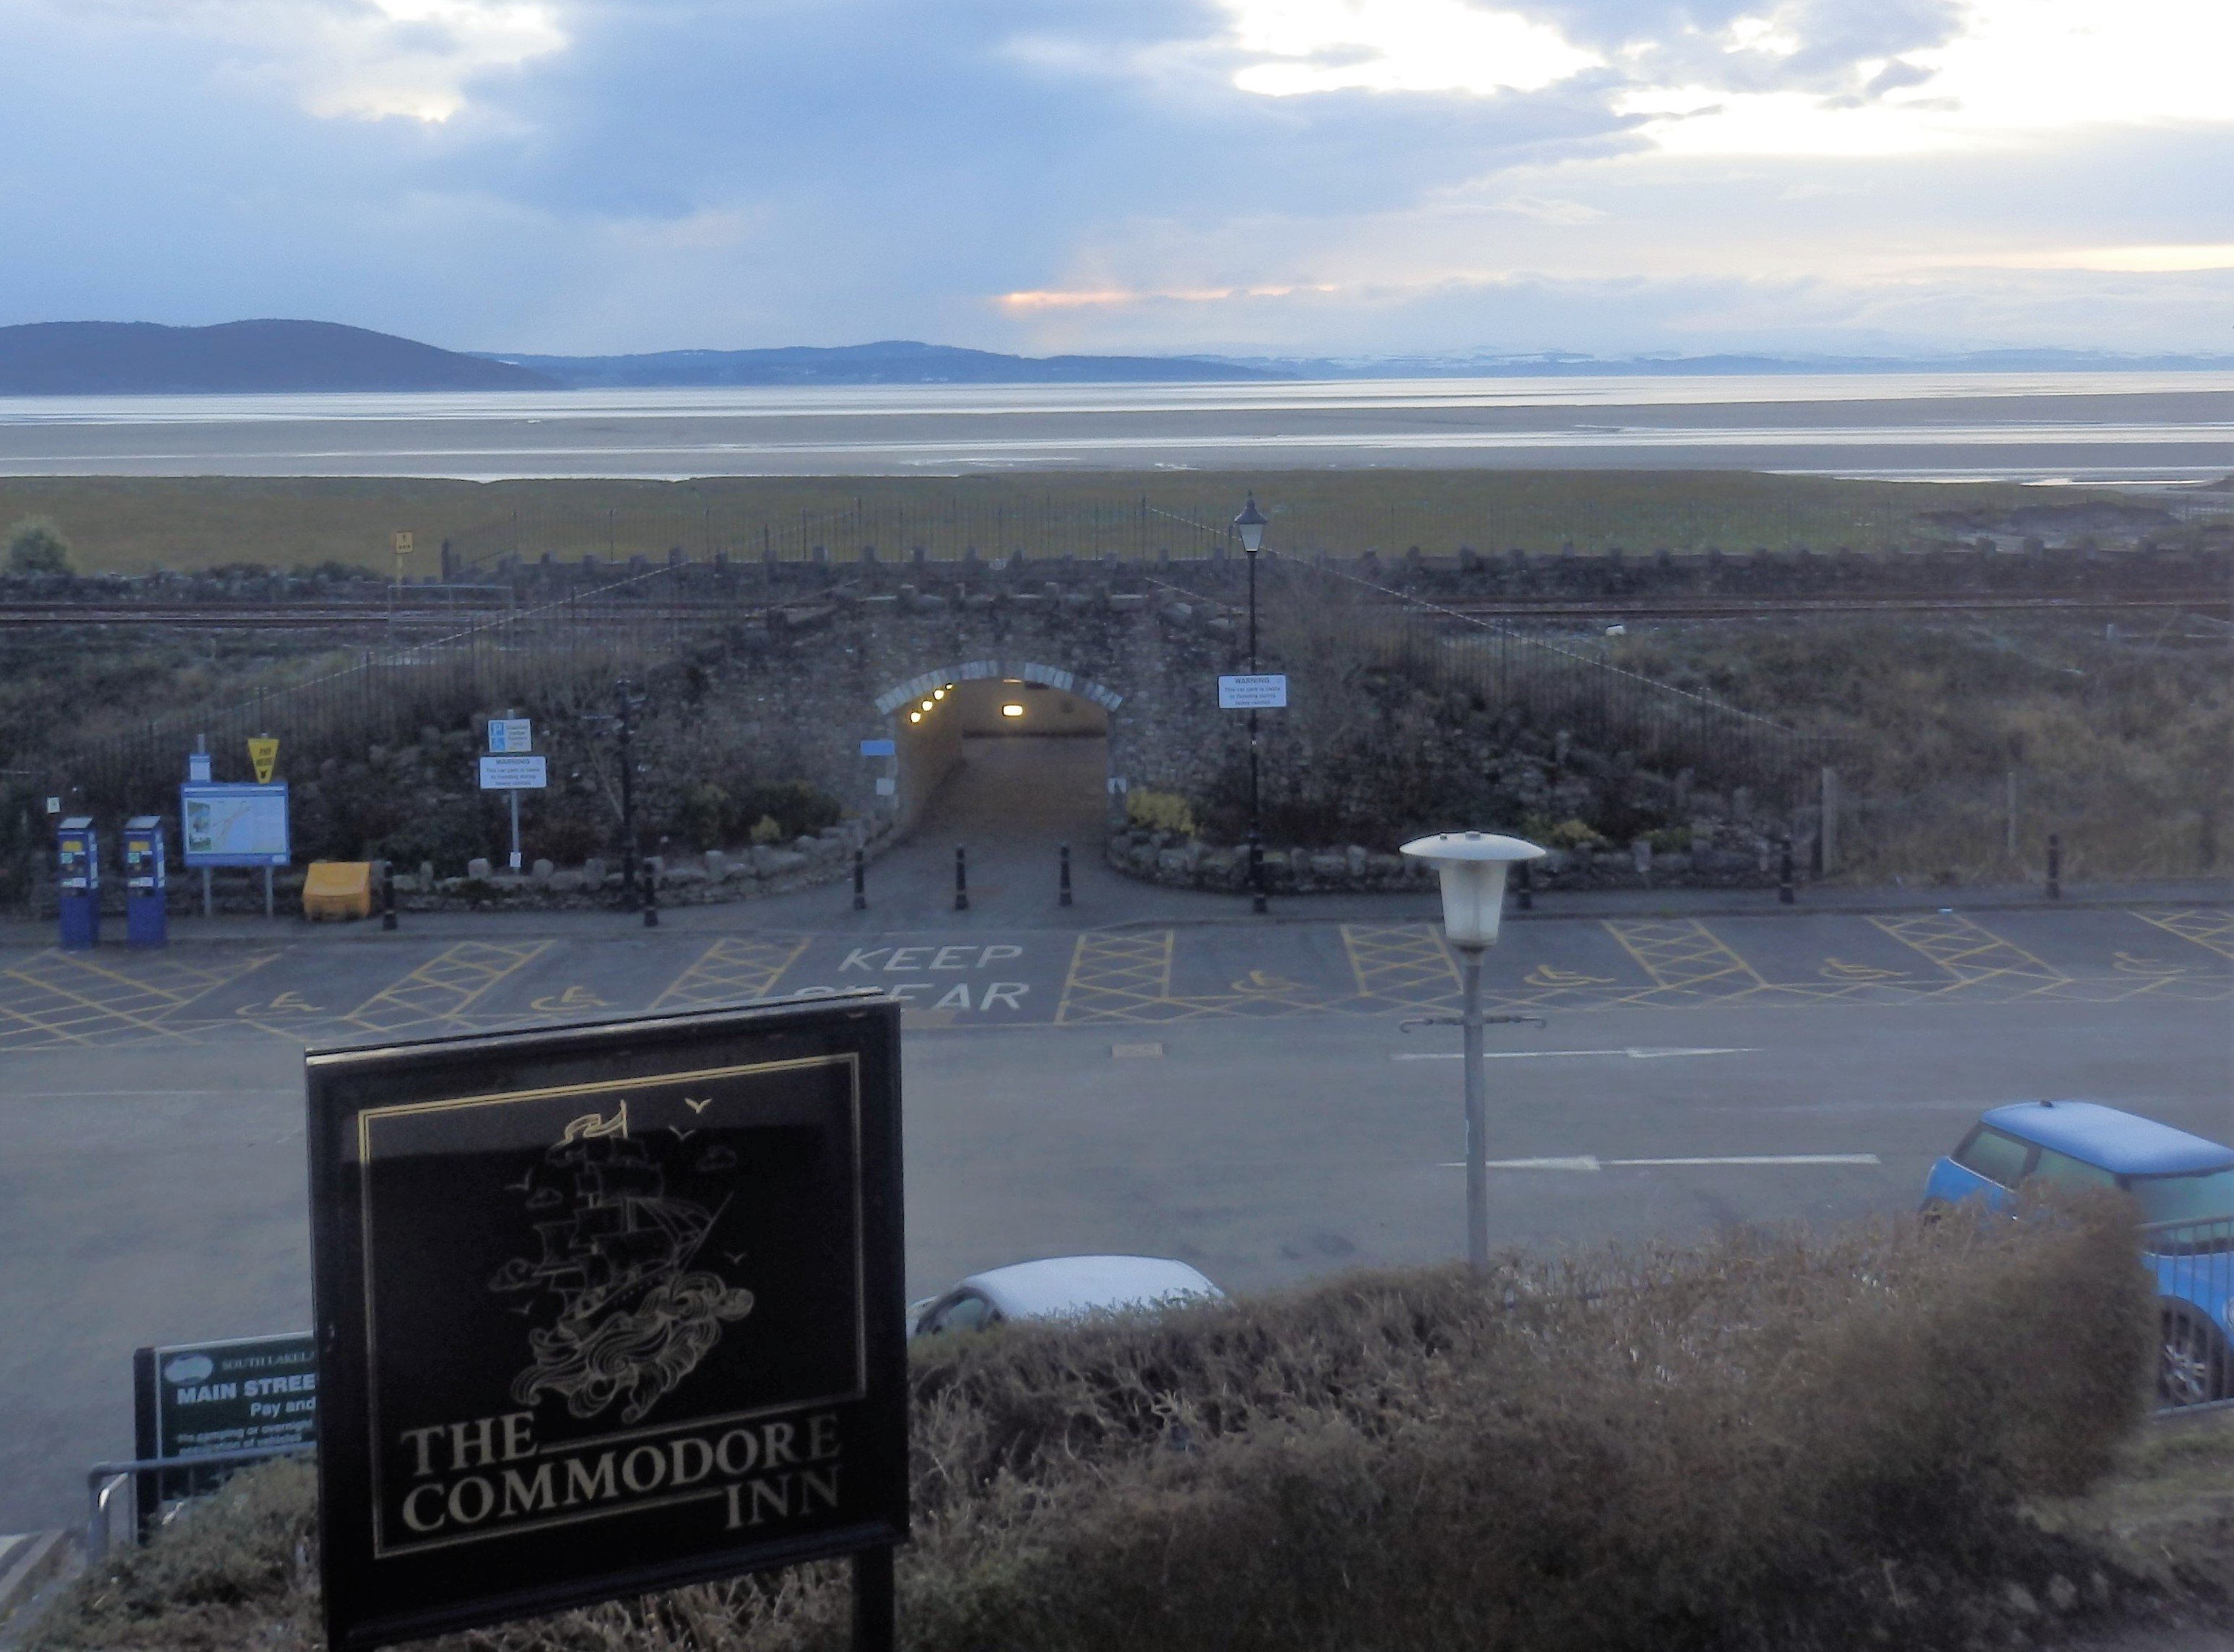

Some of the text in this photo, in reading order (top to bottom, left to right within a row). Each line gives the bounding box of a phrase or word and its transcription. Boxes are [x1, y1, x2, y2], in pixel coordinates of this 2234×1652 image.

[838, 944, 1023, 972] KEEP
[793, 981, 1031, 1012] EAR
[177, 1373, 316, 1405] MAIN STREE
[251, 1397, 316, 1418] Pay and
[401, 1411, 539, 1478] THE
[401, 1412, 842, 1534] COMMODORE
[724, 1465, 842, 1531] INN
